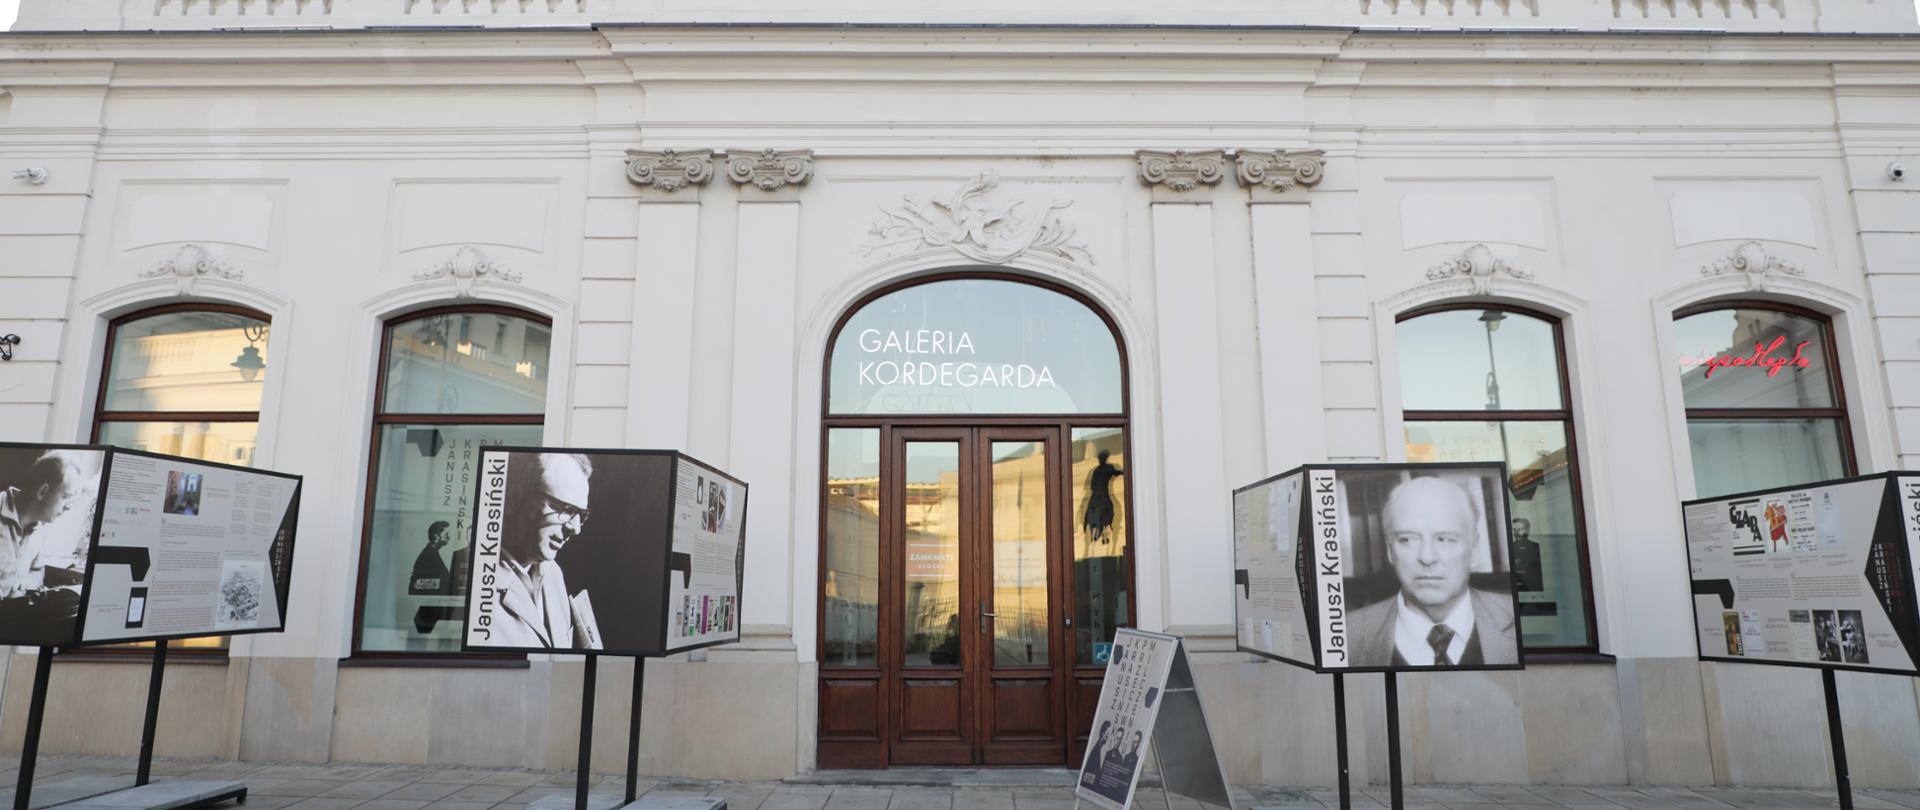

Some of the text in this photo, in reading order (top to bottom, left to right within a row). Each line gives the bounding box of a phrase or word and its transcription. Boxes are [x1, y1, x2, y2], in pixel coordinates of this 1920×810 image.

[859, 328, 975, 354] GALERIA
[859, 361, 1056, 388] KORDEGARDA
[443, 439, 456, 506] JANUSZ
[479, 458, 506, 557] Krasiński
[473, 562, 497, 641] Janusz
[1315, 476, 1346, 662] Janusz Krasiński
